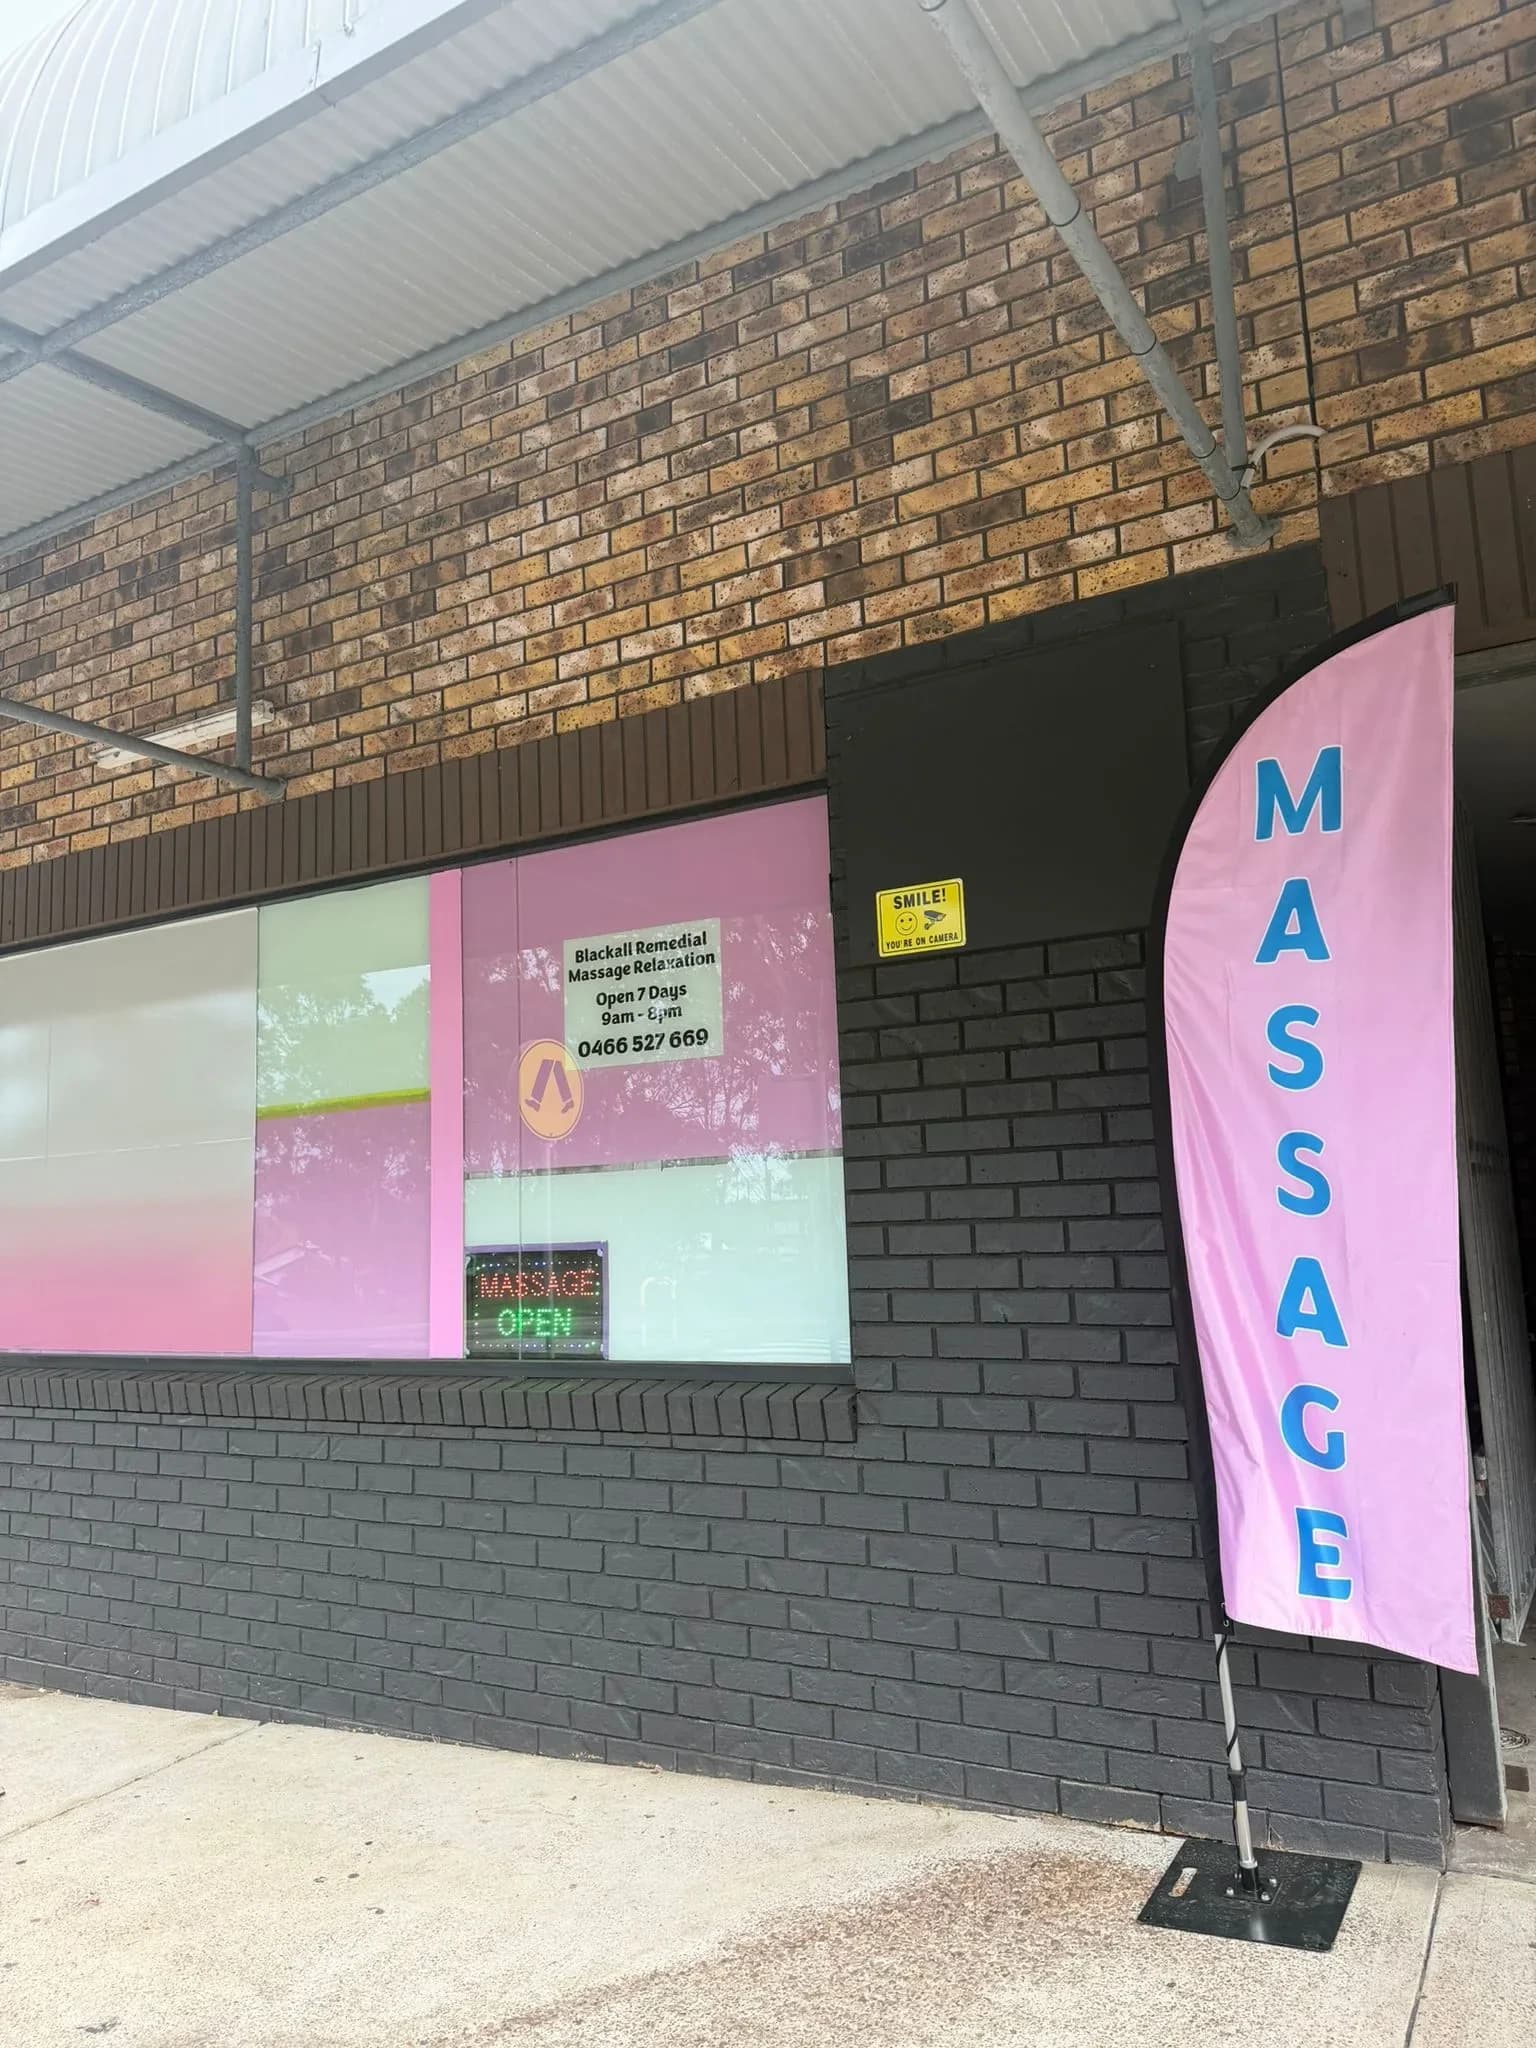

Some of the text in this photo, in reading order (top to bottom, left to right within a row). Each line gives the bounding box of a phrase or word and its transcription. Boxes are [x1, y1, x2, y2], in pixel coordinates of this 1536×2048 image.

[893, 888, 946, 909] SMILE!
[575, 931, 707, 963] Blackall Remedial
[886, 932, 959, 950] YOU'RE ON CAMERA
[568, 952, 716, 983] Massage Relaxation
[596, 984, 687, 1009] Open 7 Days
[601, 1011, 635, 1025] 9am
[647, 1006, 683, 1024] 8pm
[578, 1028, 709, 1057] 0466 527 669
[1254, 745, 1354, 1601] MASSAGE
[480, 1268, 595, 1297] MASSAGE
[498, 1307, 572, 1337] OPEN
